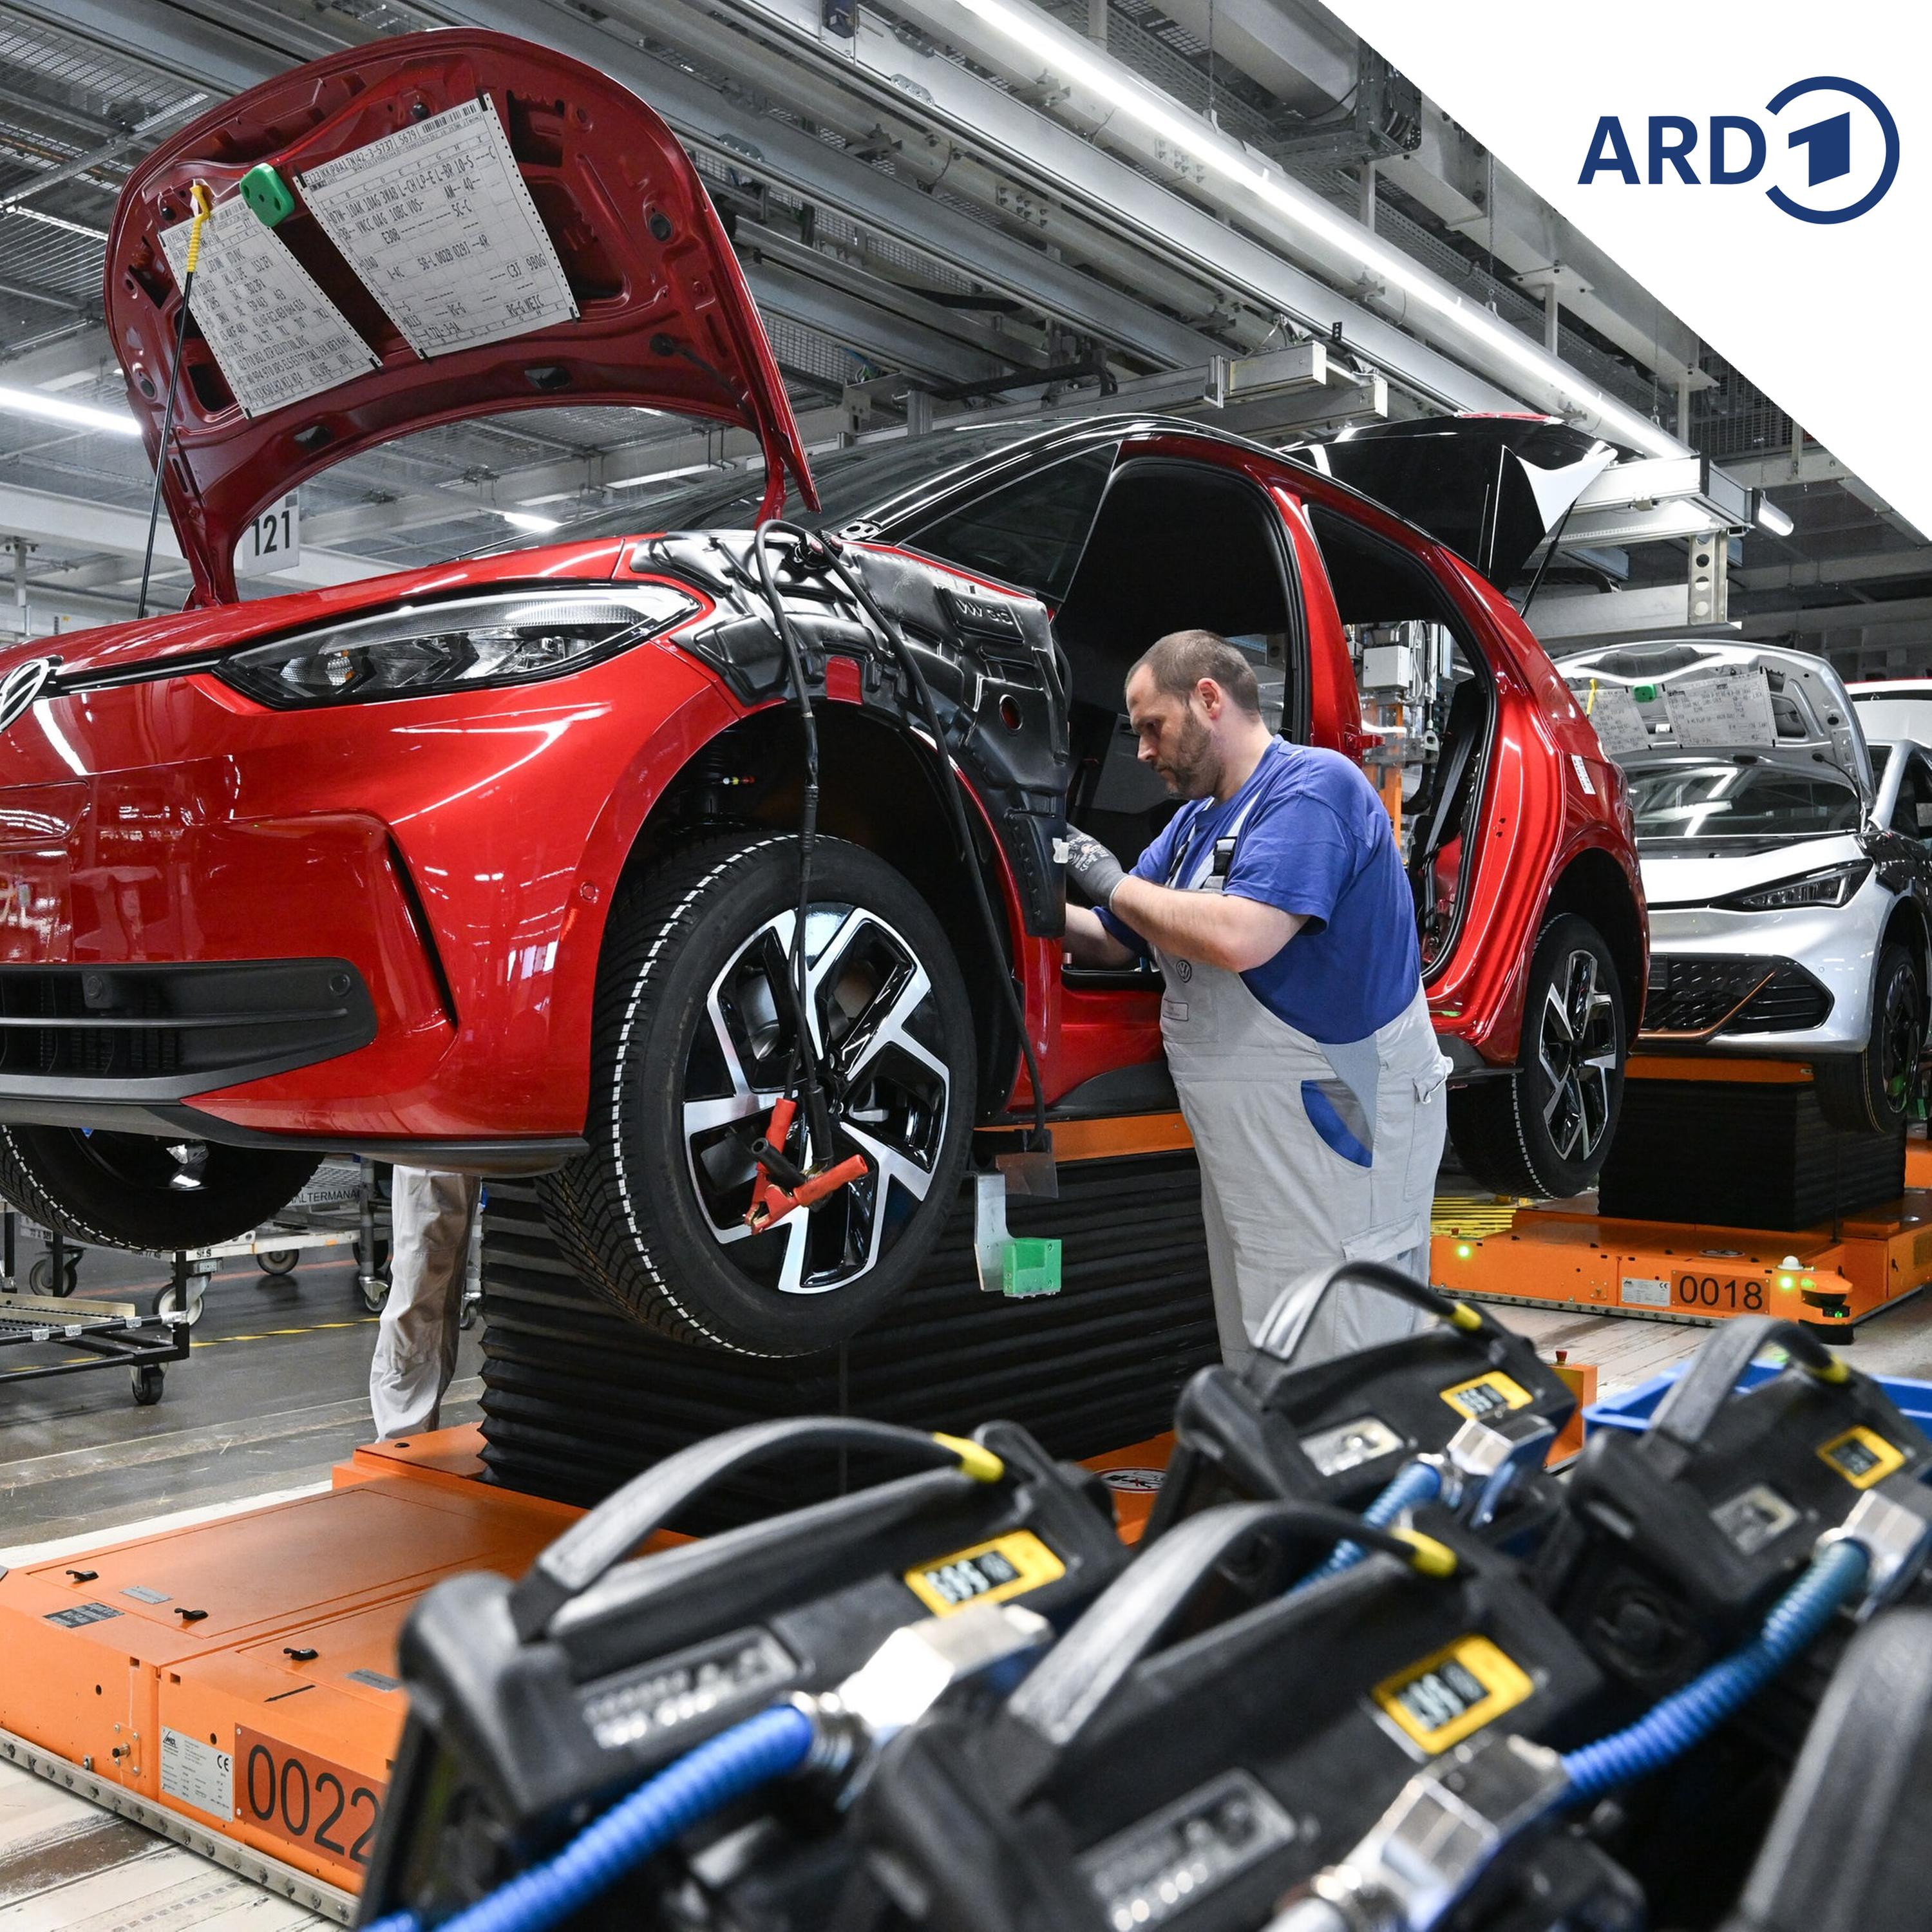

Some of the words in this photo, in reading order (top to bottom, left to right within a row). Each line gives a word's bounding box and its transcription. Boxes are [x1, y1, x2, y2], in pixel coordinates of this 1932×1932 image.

[397, 128, 418, 145] 5679
[414, 170, 437, 189] LP-E
[252, 511, 290, 556] 121
[291, 1189, 360, 1203] ALTERMANA
[1680, 1276, 1763, 1310] 0018
[248, 1744, 381, 1864] 0022
